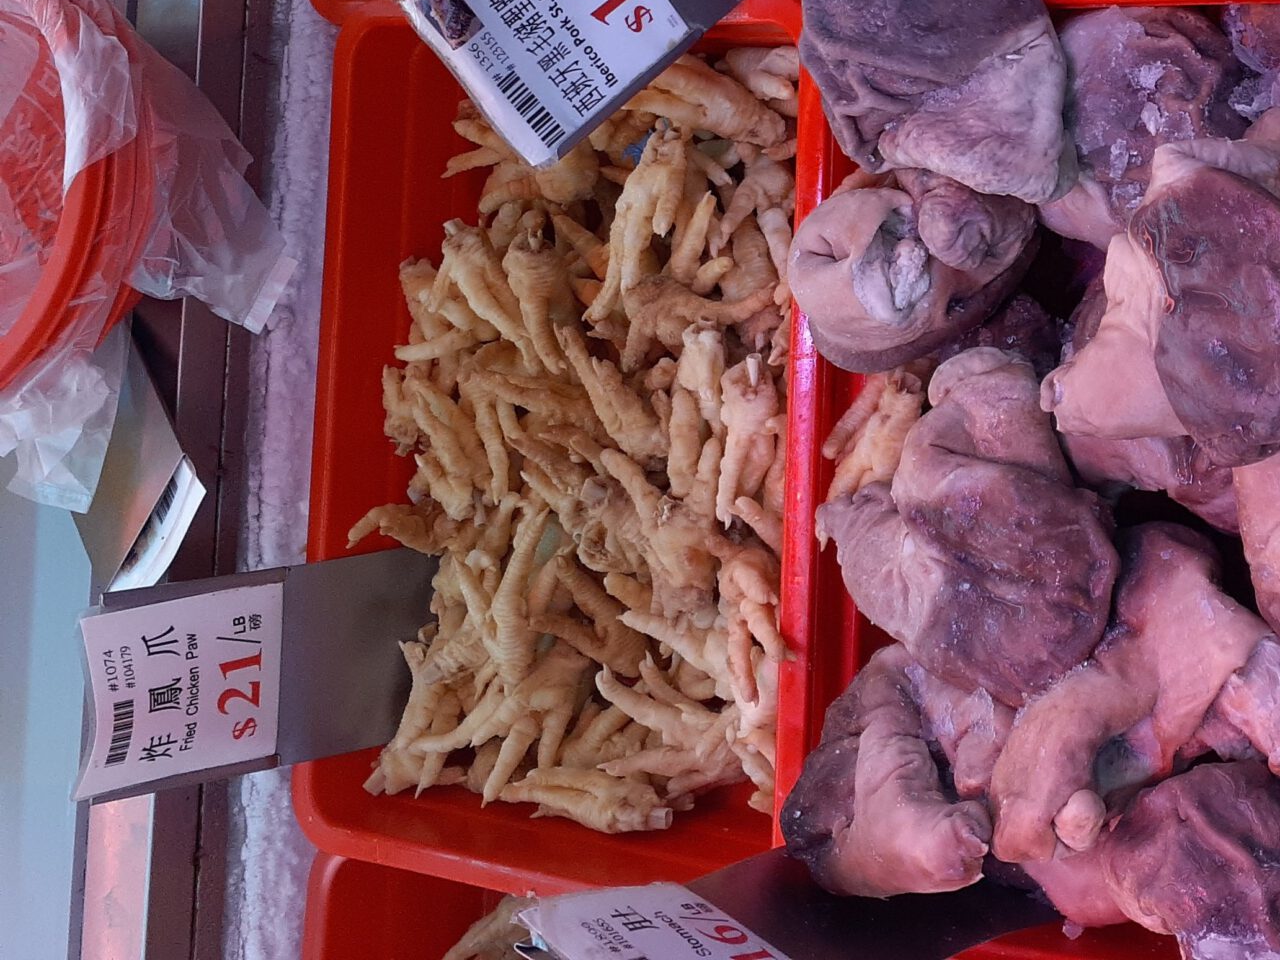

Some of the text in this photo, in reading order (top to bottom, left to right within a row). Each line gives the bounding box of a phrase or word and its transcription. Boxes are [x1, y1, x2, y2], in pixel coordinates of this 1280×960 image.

[564, 15, 588, 45] Pork
[584, 44, 619, 88] Iberico
[248, 614, 261, 631] 磅
[103, 649, 119, 692] #1074
[120, 646, 136, 689] #104179
[179, 633, 199, 751] Fried Chicken Paw
[654, 911, 712, 957] Stomach
